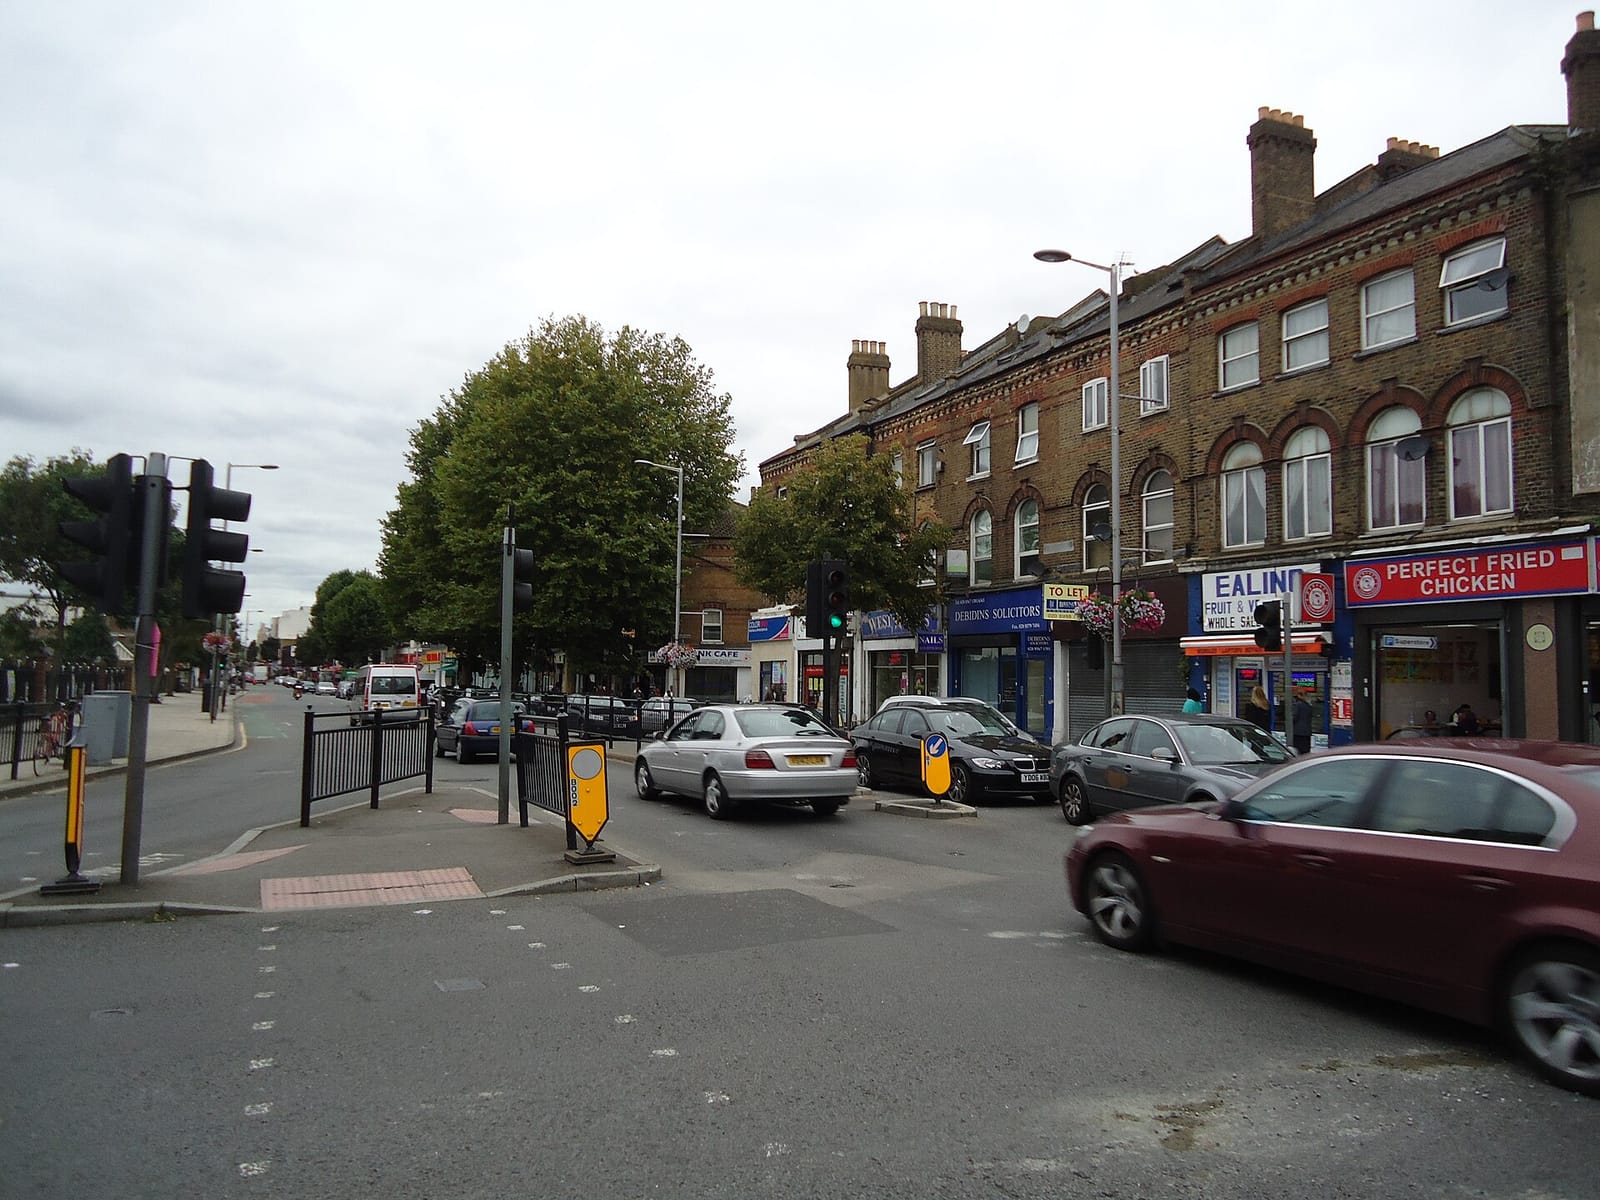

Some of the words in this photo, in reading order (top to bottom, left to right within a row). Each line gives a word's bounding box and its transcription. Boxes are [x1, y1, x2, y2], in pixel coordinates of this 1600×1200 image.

[1386, 556, 1479, 580] PERFECT
[1487, 549, 1555, 572] FRIED
[1420, 572, 1516, 595] CHICKEN
[1049, 587, 1064, 597] TO
[1067, 587, 1084, 597] LET
[954, 607, 990, 622] DEBIDINS
[992, 605, 1040, 620] SOLICITORS
[1205, 601, 1232, 615] FRUIT
[1238, 600, 1244, 613] &
[1208, 616, 1235, 629] WHOLE
[919, 635, 943, 645] NAILS
[714, 650, 739, 658] CAFE
